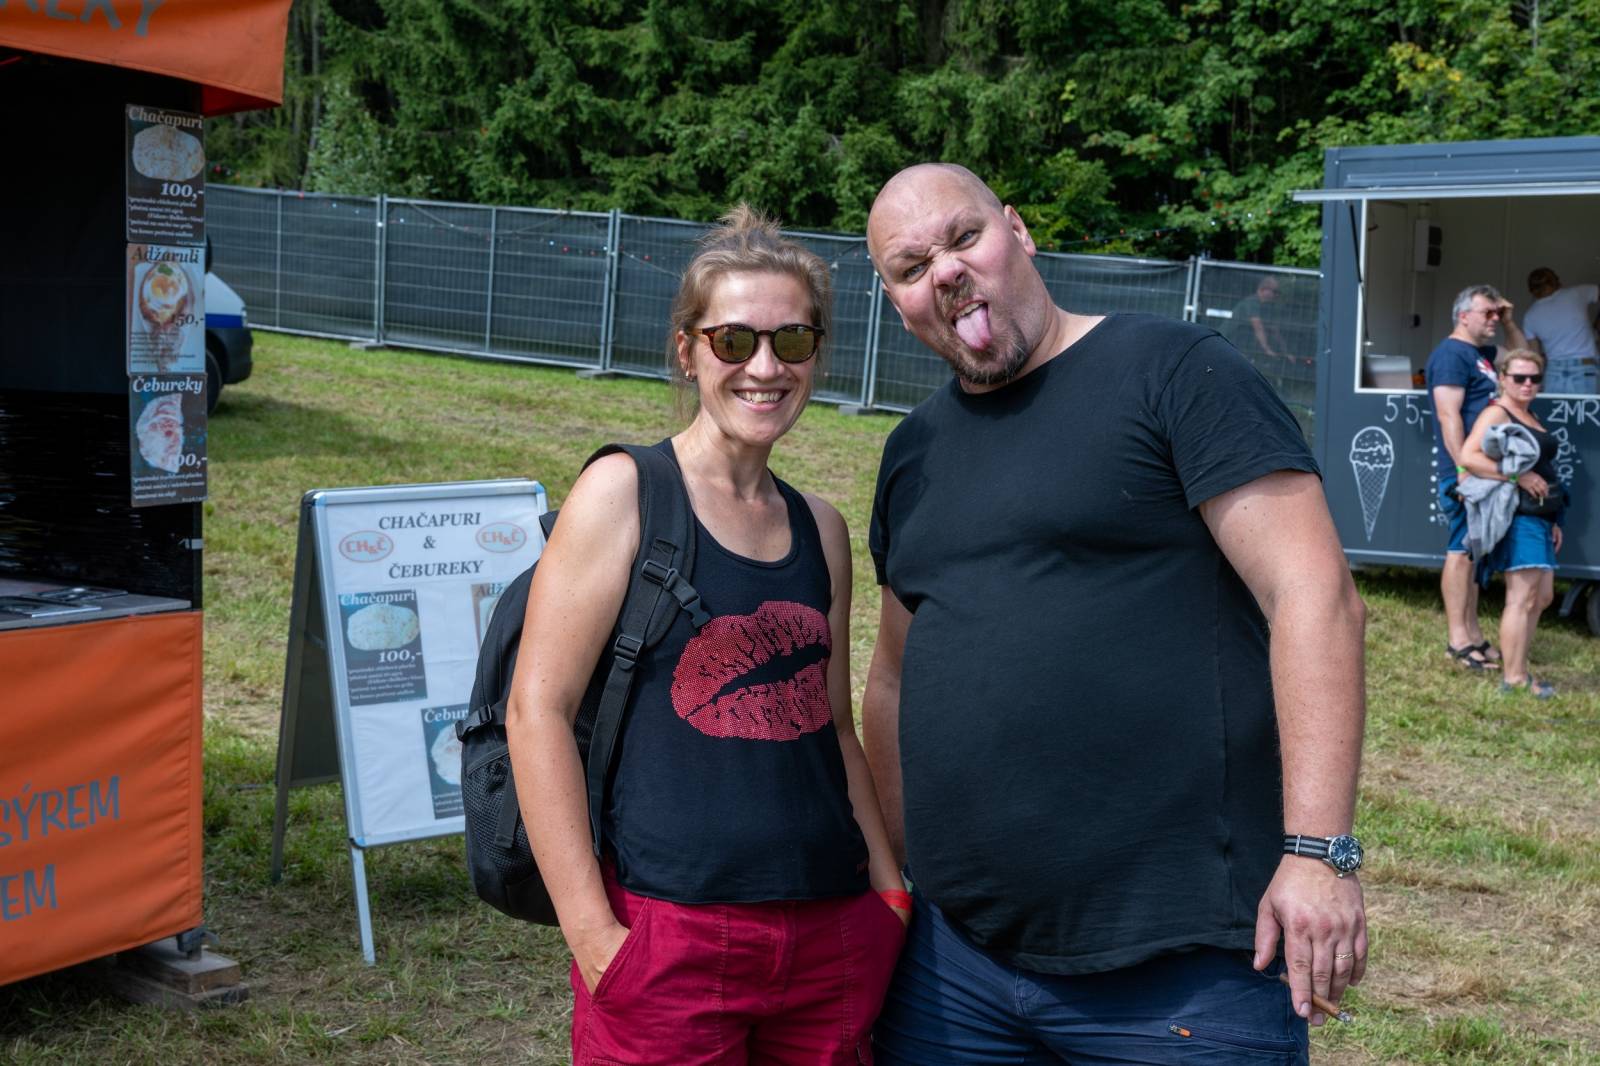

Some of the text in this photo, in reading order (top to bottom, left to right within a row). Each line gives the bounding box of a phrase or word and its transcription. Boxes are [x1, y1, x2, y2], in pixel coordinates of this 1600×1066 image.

[128, 106, 203, 129] Chačapuri
[160, 183, 204, 201] 100,-
[132, 246, 199, 264] Adžaruli
[132, 376, 203, 394] Čebureky
[378, 511, 481, 530] CHAČAPURI
[423, 535, 436, 549] &
[388, 559, 484, 579] ČEBUREKY
[340, 589, 416, 606] Chačapuri
[378, 649, 422, 663] 100,-
